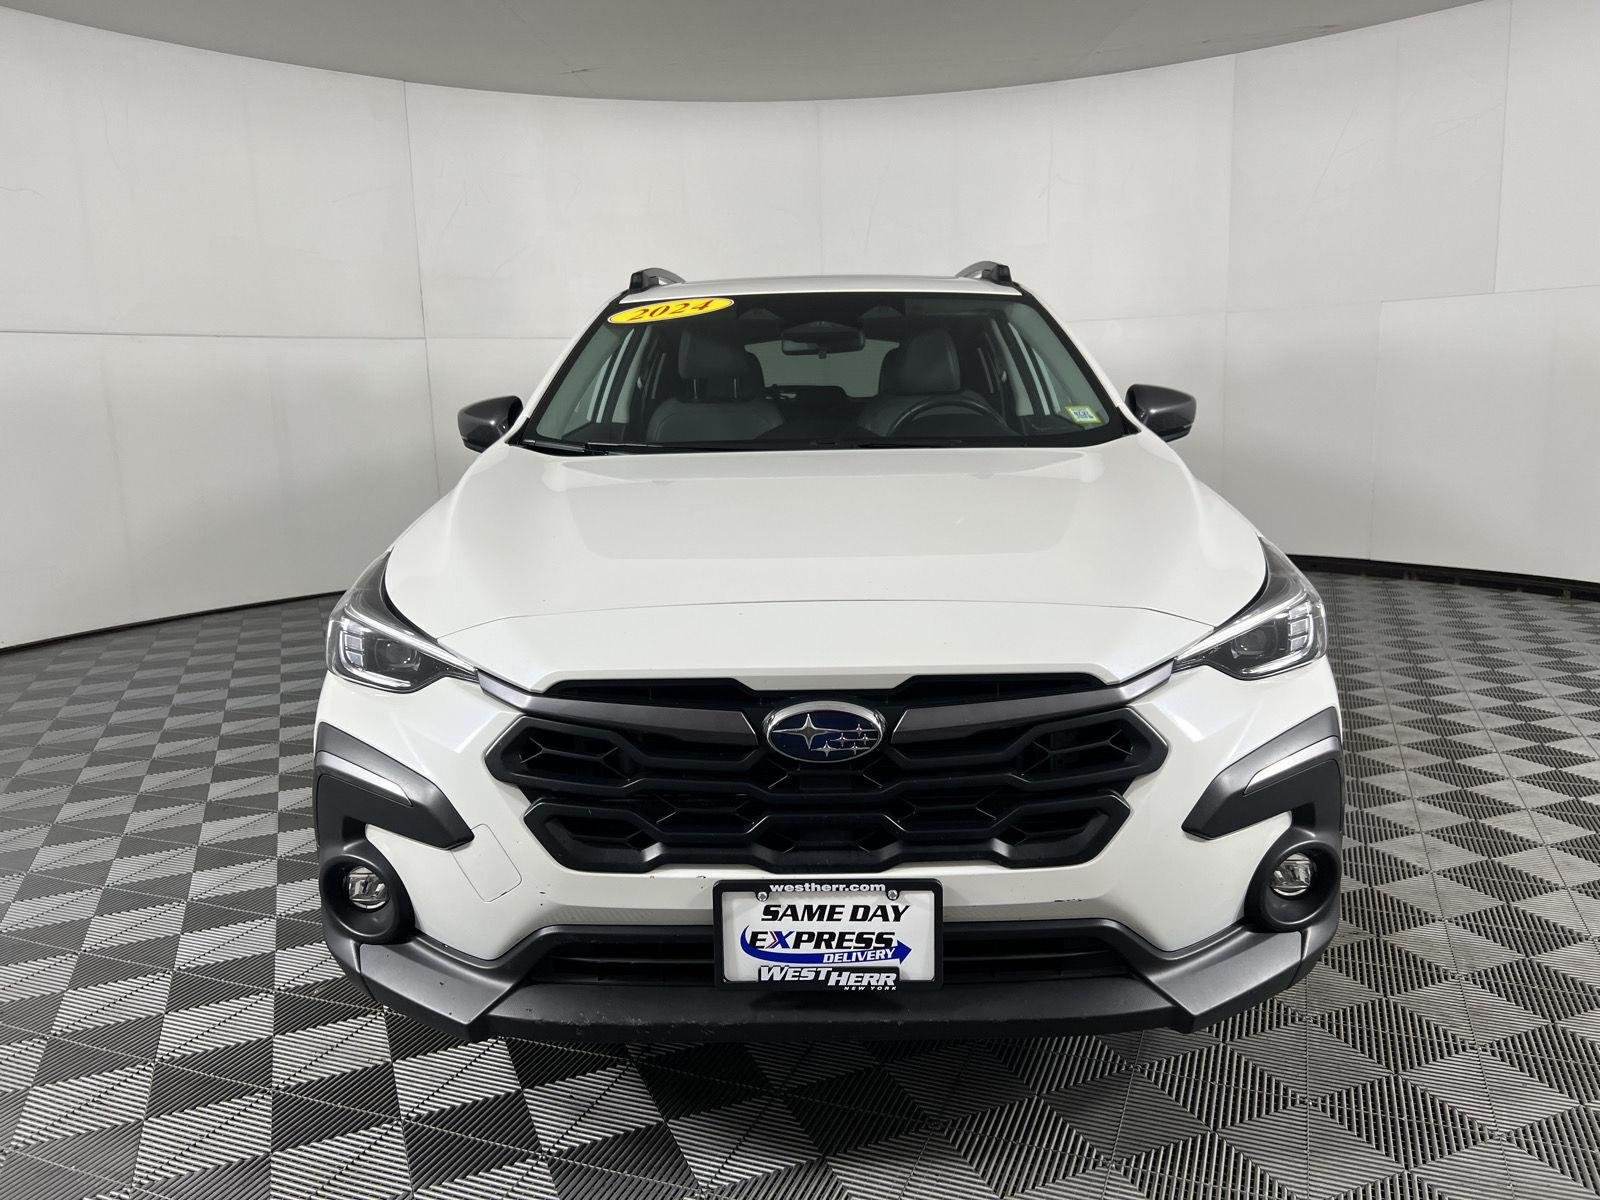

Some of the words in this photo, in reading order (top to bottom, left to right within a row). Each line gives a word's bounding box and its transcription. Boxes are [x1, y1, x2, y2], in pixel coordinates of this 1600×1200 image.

[628, 299, 714, 321] 2024
[769, 883, 886, 892] westherr.com
[761, 904, 845, 922] SAME
[850, 904, 910, 922] DAY
[749, 931, 896, 950] EXPRESS
[822, 947, 896, 964] DELIVERY
